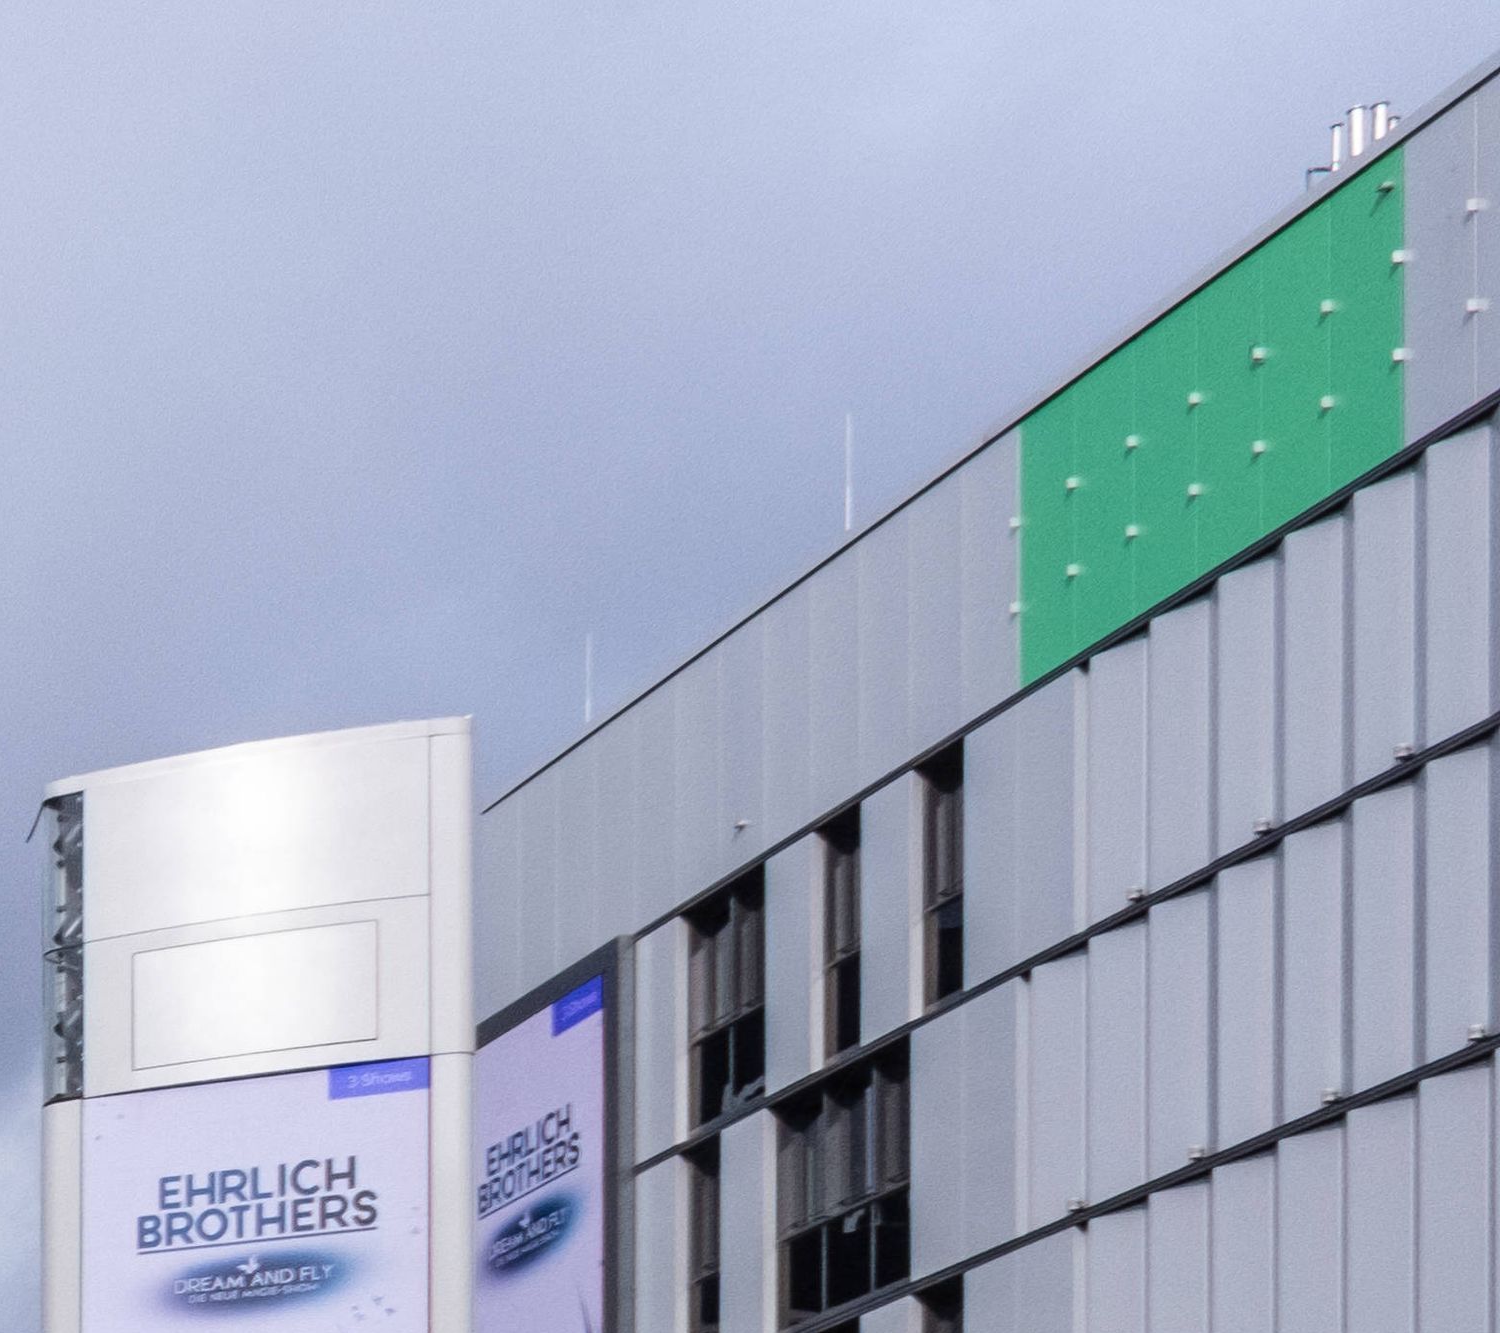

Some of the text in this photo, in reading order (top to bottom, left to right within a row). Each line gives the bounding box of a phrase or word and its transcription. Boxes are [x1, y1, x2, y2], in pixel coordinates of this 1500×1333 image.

[487, 1103, 571, 1177] EHRLICH
[159, 1155, 357, 1211] EHRLICH
[478, 1132, 580, 1215] BROTHERS
[136, 1190, 378, 1250] BROTHERS
[174, 1264, 335, 1294] DREAM AND FLY
